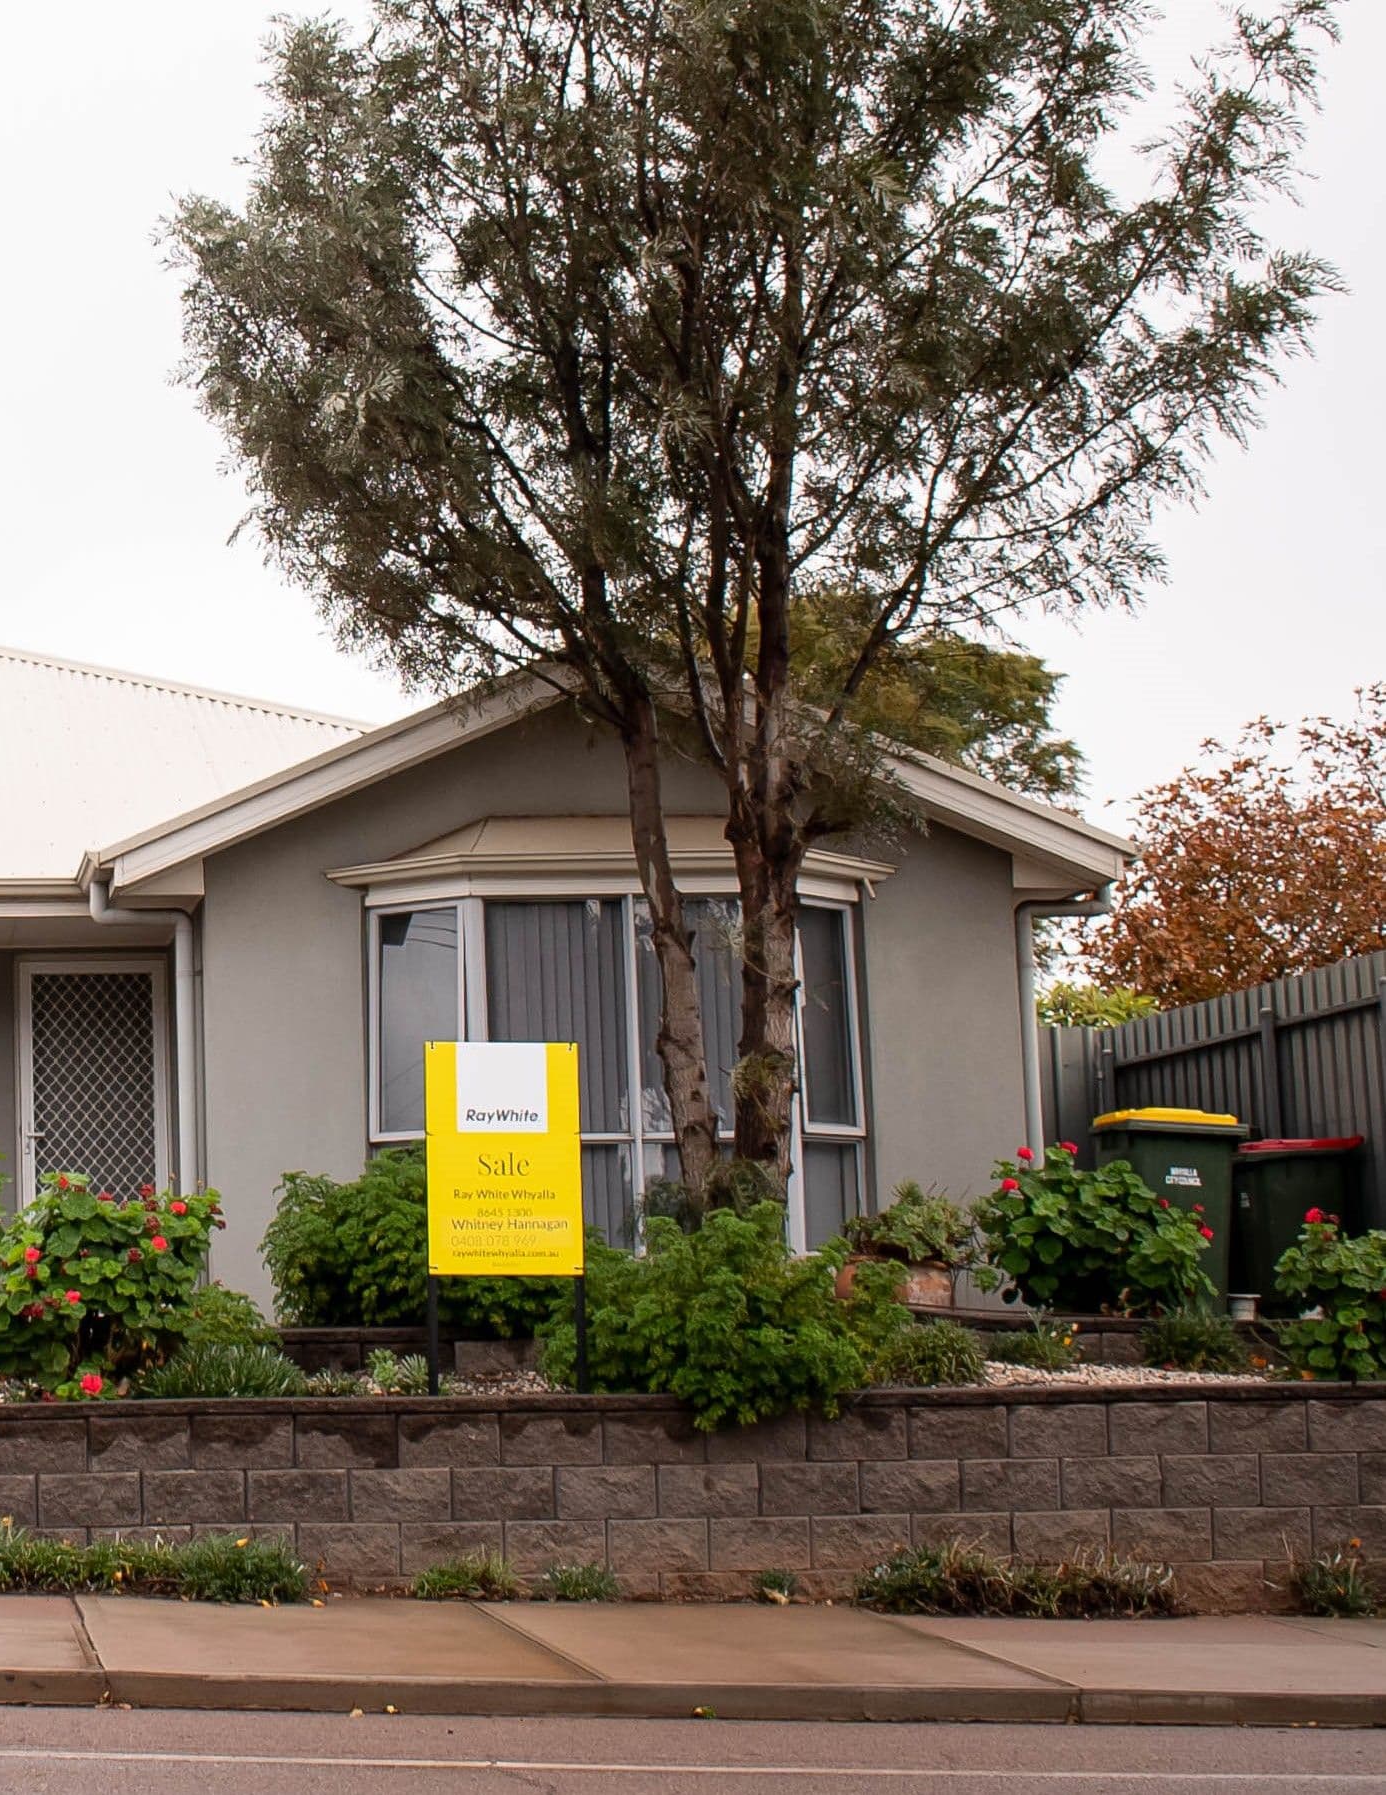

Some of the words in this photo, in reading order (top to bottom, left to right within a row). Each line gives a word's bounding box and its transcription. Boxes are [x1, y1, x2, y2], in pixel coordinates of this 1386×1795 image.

[478, 1152, 530, 1177] Sale
[453, 1188, 473, 1200] Ray
[476, 1188, 509, 1199] White
[511, 1188, 557, 1200] Whyalla
[477, 1207, 503, 1217] 8645
[451, 1218, 503, 1231] Whitney
[508, 1218, 568, 1231] Hannagan
[486, 1234, 509, 1247] 078
